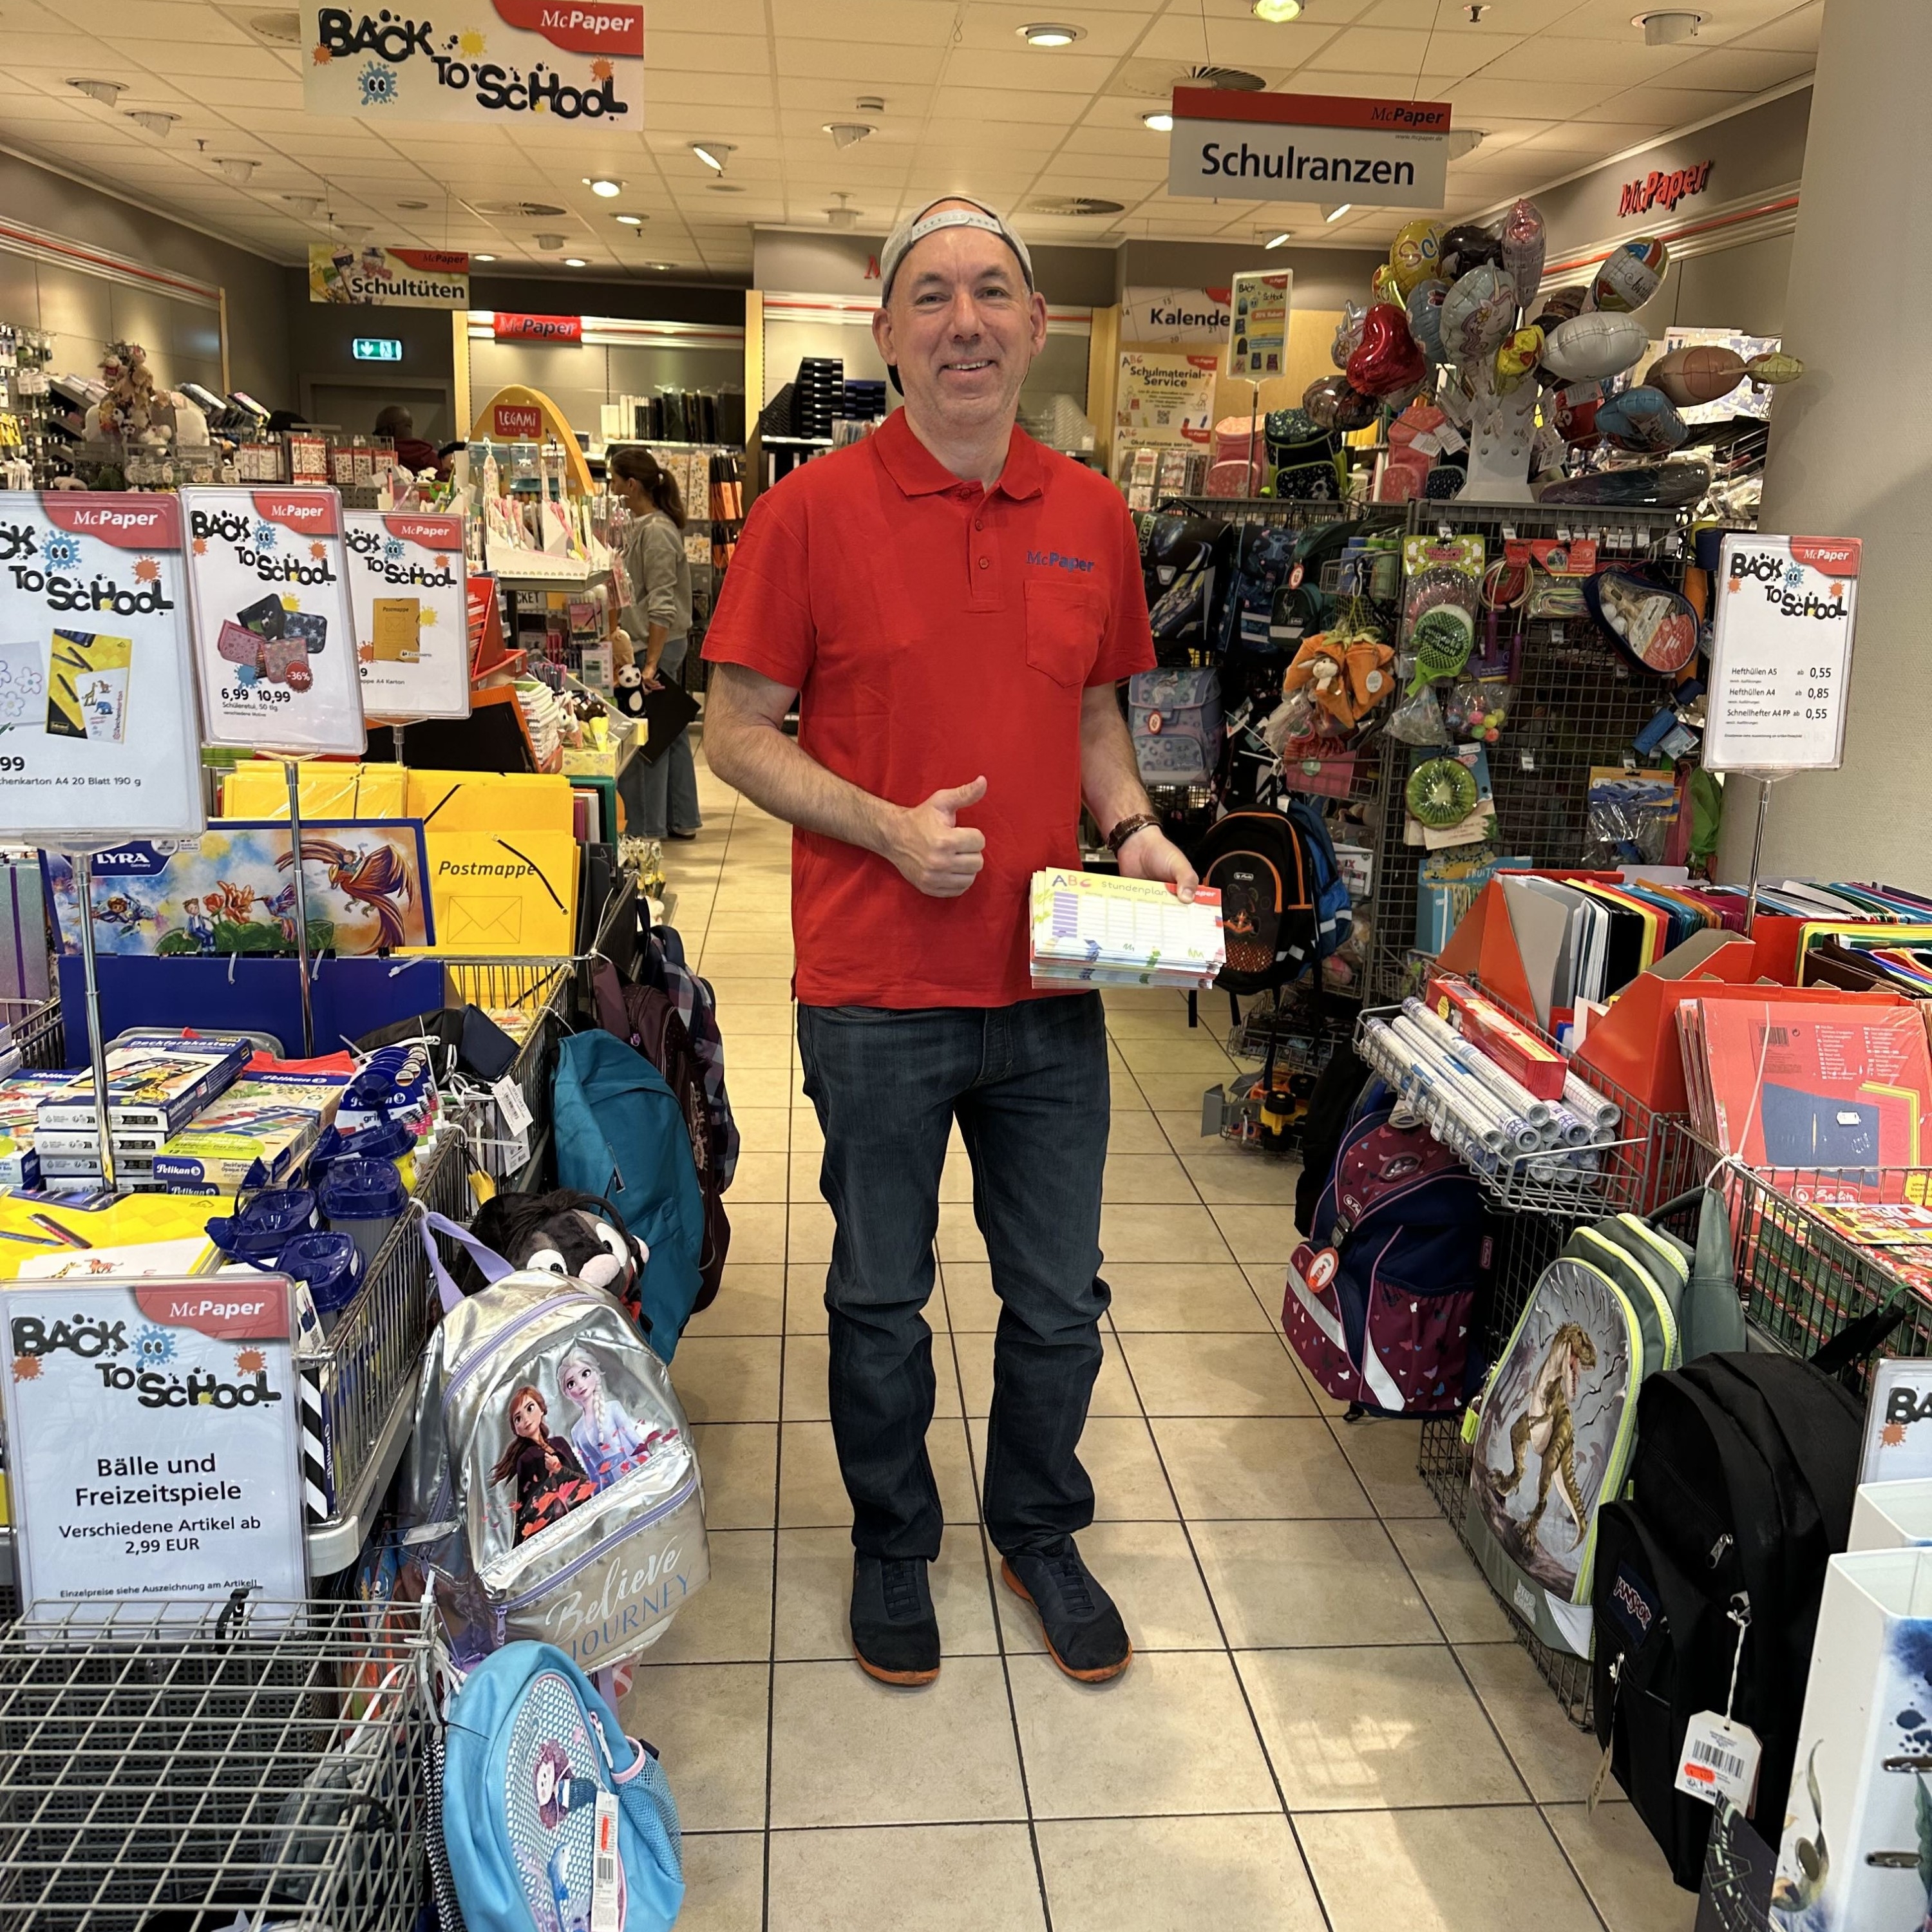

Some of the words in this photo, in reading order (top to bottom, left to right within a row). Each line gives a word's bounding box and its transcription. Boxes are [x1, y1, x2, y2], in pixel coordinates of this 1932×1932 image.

[541, 10, 634, 34] McPaper
[318, 8, 434, 62] BACK
[1370, 107, 1444, 126] McPaper
[1201, 142, 1414, 185] Schulranzen
[1616, 160, 1711, 218] McPaper
[423, 253, 465, 265] McPaper
[352, 277, 465, 299] Schultüten
[498, 316, 578, 337] McPaper
[1130, 366, 1206, 379] Schulmaterial-
[1144, 376, 1188, 388] Service
[73, 510, 158, 529] McPaper
[272, 504, 324, 520] McPaper
[191, 510, 252, 542] BACK
[401, 526, 450, 538] McPaper
[1026, 550, 1095, 573] McPaper
[1804, 549, 1850, 562] McPaper
[1731, 552, 1783, 582] BACK
[287, 671, 310, 681] -36%
[1732, 667, 1766, 676] Hefthüllen
[1810, 667, 1832, 679] 0,55
[221, 688, 249, 701] 6,99
[257, 690, 291, 704] 10,99
[1730, 688, 1765, 696] Hefthüllen
[1808, 688, 1830, 699] 0,85
[1727, 708, 1771, 717] Schnellhefter
[1806, 708, 1828, 720] 0,55
[134, 779, 141, 787] g
[97, 853, 150, 864] LYRA
[438, 861, 535, 878] Postmappe
[156, 1164, 190, 1175] Pelikan
[169, 1300, 265, 1318] McPaper
[11, 1314, 129, 1357] BACK
[97, 1456, 159, 1477] Bälle
[167, 1454, 216, 1474] und
[75, 1481, 242, 1507] Freizeitspiele
[59, 1520, 173, 1539] Verschiedene
[178, 1517, 235, 1533] Artikel
[240, 1516, 261, 1530] ab
[124, 1539, 161, 1555] 2,99
[166, 1538, 200, 1552] EUR
[60, 1587, 114, 1598] Einzelpreise
[116, 1585, 140, 1595] siehe
[142, 1582, 205, 1593] Auszeichnung
[545, 1535, 683, 1645] Believe
